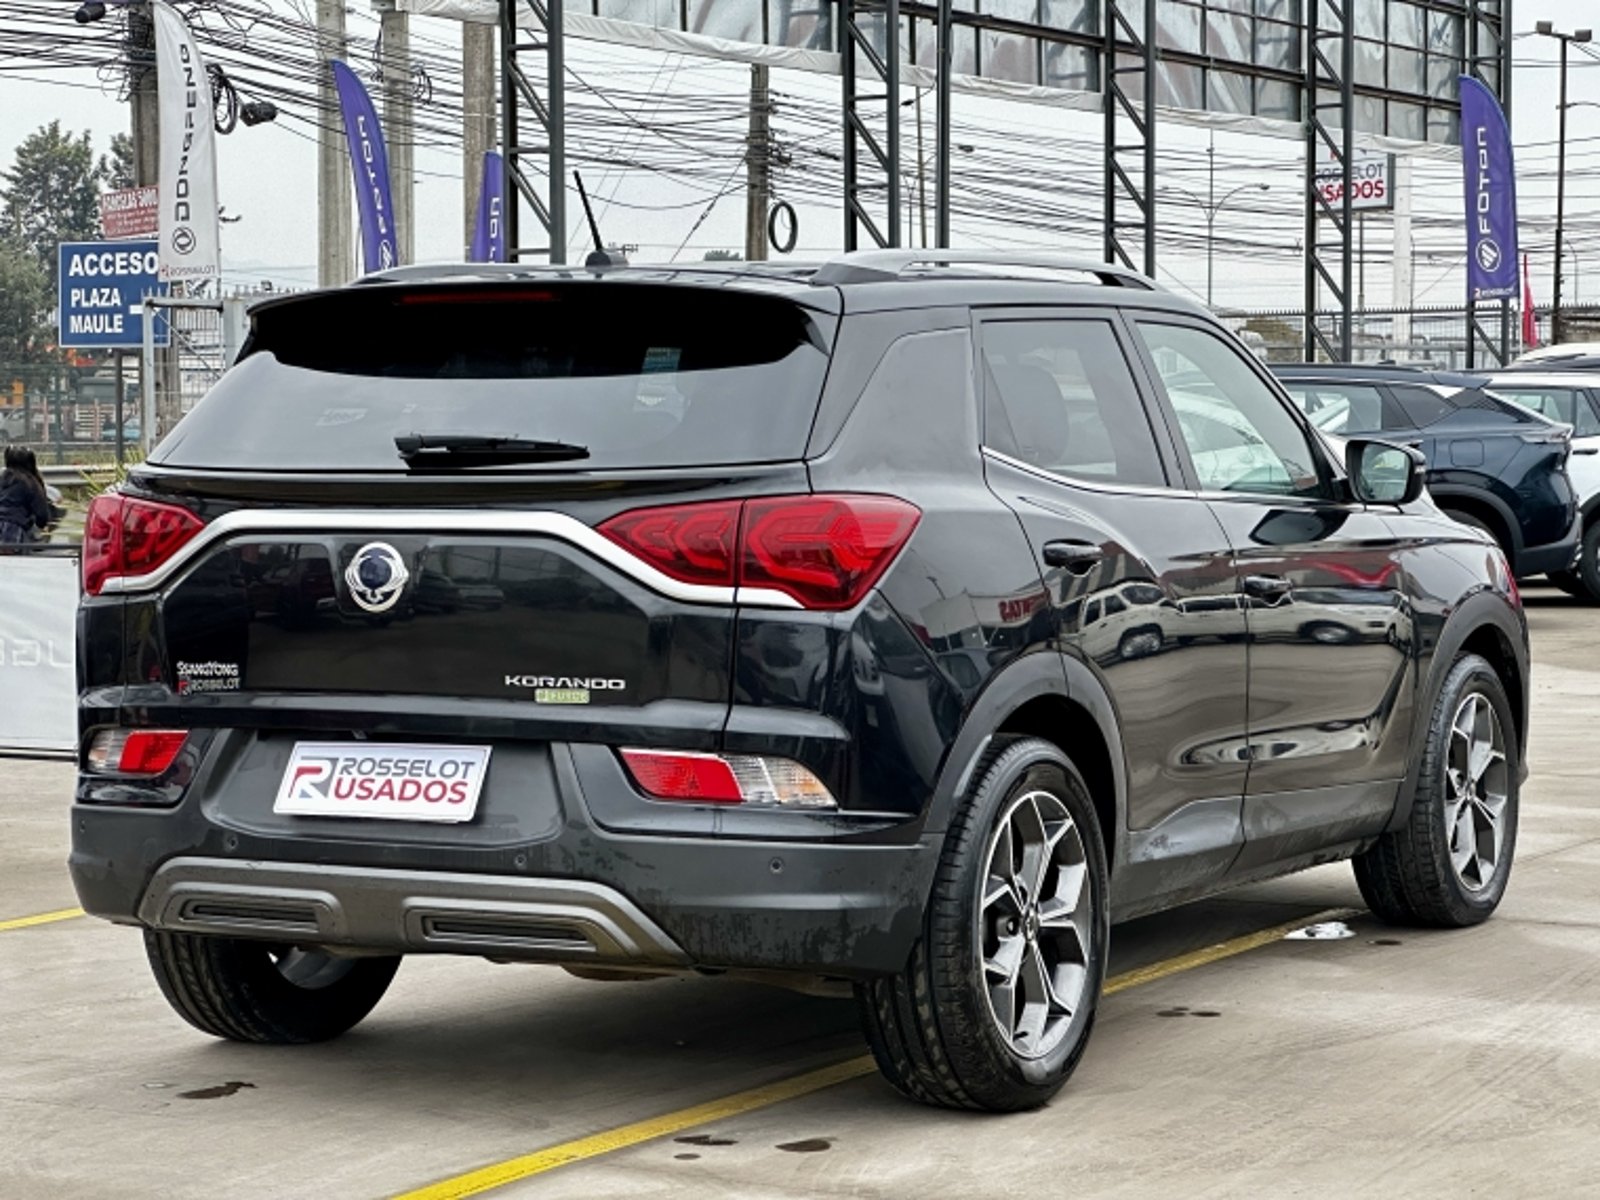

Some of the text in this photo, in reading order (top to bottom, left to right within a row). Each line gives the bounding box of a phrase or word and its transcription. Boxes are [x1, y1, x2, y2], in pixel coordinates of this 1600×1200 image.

[174, 43, 196, 221] DONGFENG
[69, 251, 158, 276] ACCESO
[71, 288, 121, 307] PLAZA
[70, 314, 124, 334] MAULE
[504, 674, 626, 690] KORANDO
[338, 757, 475, 780] ROSSELOT
[332, 777, 469, 804] USADOS
